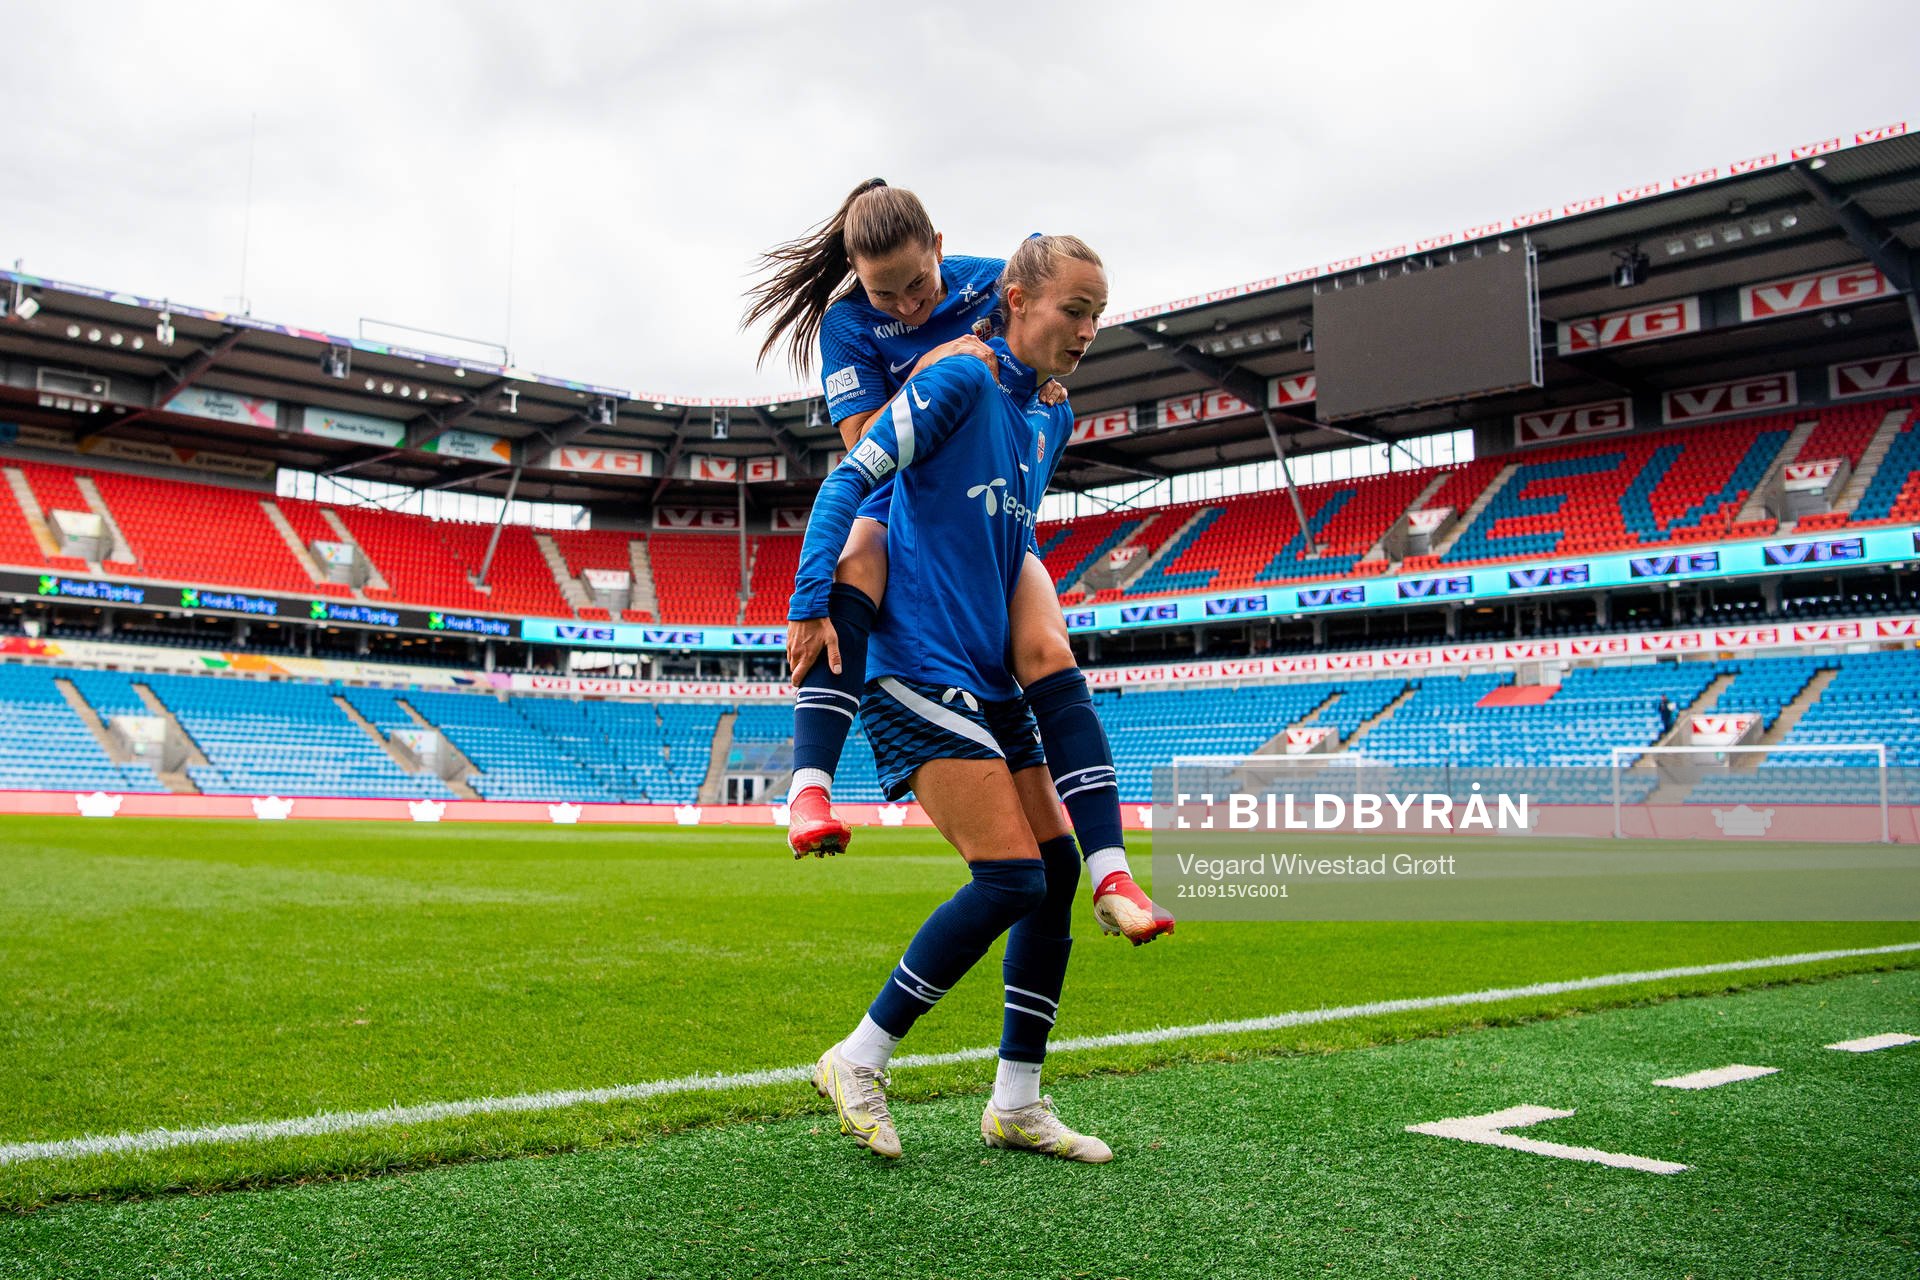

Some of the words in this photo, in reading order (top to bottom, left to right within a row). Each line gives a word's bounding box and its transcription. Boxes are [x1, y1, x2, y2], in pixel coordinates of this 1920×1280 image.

[1855, 121, 1906, 145] VG
[1792, 137, 1840, 160] VG
[1730, 153, 1777, 176] VG
[1673, 167, 1717, 190] VG
[1617, 182, 1660, 203] VG
[1564, 197, 1605, 216] VG
[1513, 209, 1552, 228] VG
[1464, 222, 1501, 241] VG
[1416, 234, 1453, 251] VG
[1372, 246, 1406, 262] VG
[1328, 256, 1361, 273] VG
[1752, 266, 1885, 317] VG
[873, 321, 905, 339] KIWI
[1570, 303, 1685, 350] VG
[828, 370, 854, 395] DNB
[1838, 355, 1920, 396] V
[1279, 375, 1316, 404] V
[1669, 376, 1789, 420] VG
[1166, 391, 1246, 424] VG
[1520, 402, 1626, 441] VG
[560, 447, 642, 473] VG
[859, 445, 888, 472] DNB
[701, 456, 777, 481] VG
[659, 508, 740, 529] VG
[1764, 538, 1864, 566] VG
[1630, 551, 1719, 578] VG
[1508, 564, 1589, 588] VG
[1298, 586, 1364, 607] VG
[1398, 576, 1472, 598] VG
[1121, 604, 1177, 623] VG
[1206, 595, 1267, 616] VG
[557, 625, 614, 640] VG
[644, 630, 703, 644] VG
[1715, 628, 1779, 647] VG
[1794, 623, 1861, 642] VG
[1877, 619, 1920, 637] V
[1506, 643, 1559, 659] VG
[1572, 638, 1627, 655] VG
[1641, 634, 1701, 650] VG
[1327, 654, 1373, 670] VG
[1383, 650, 1432, 666] VG
[1443, 646, 1494, 663] VG
[1126, 667, 1164, 681] VG
[1173, 664, 1212, 678] VG
[1222, 661, 1263, 676] VG
[1273, 658, 1317, 672] VG
[532, 677, 570, 690] VG
[579, 678, 620, 692] VG
[630, 679, 670, 693] VG
[680, 680, 720, 694] VG
[730, 680, 770, 695] VG
